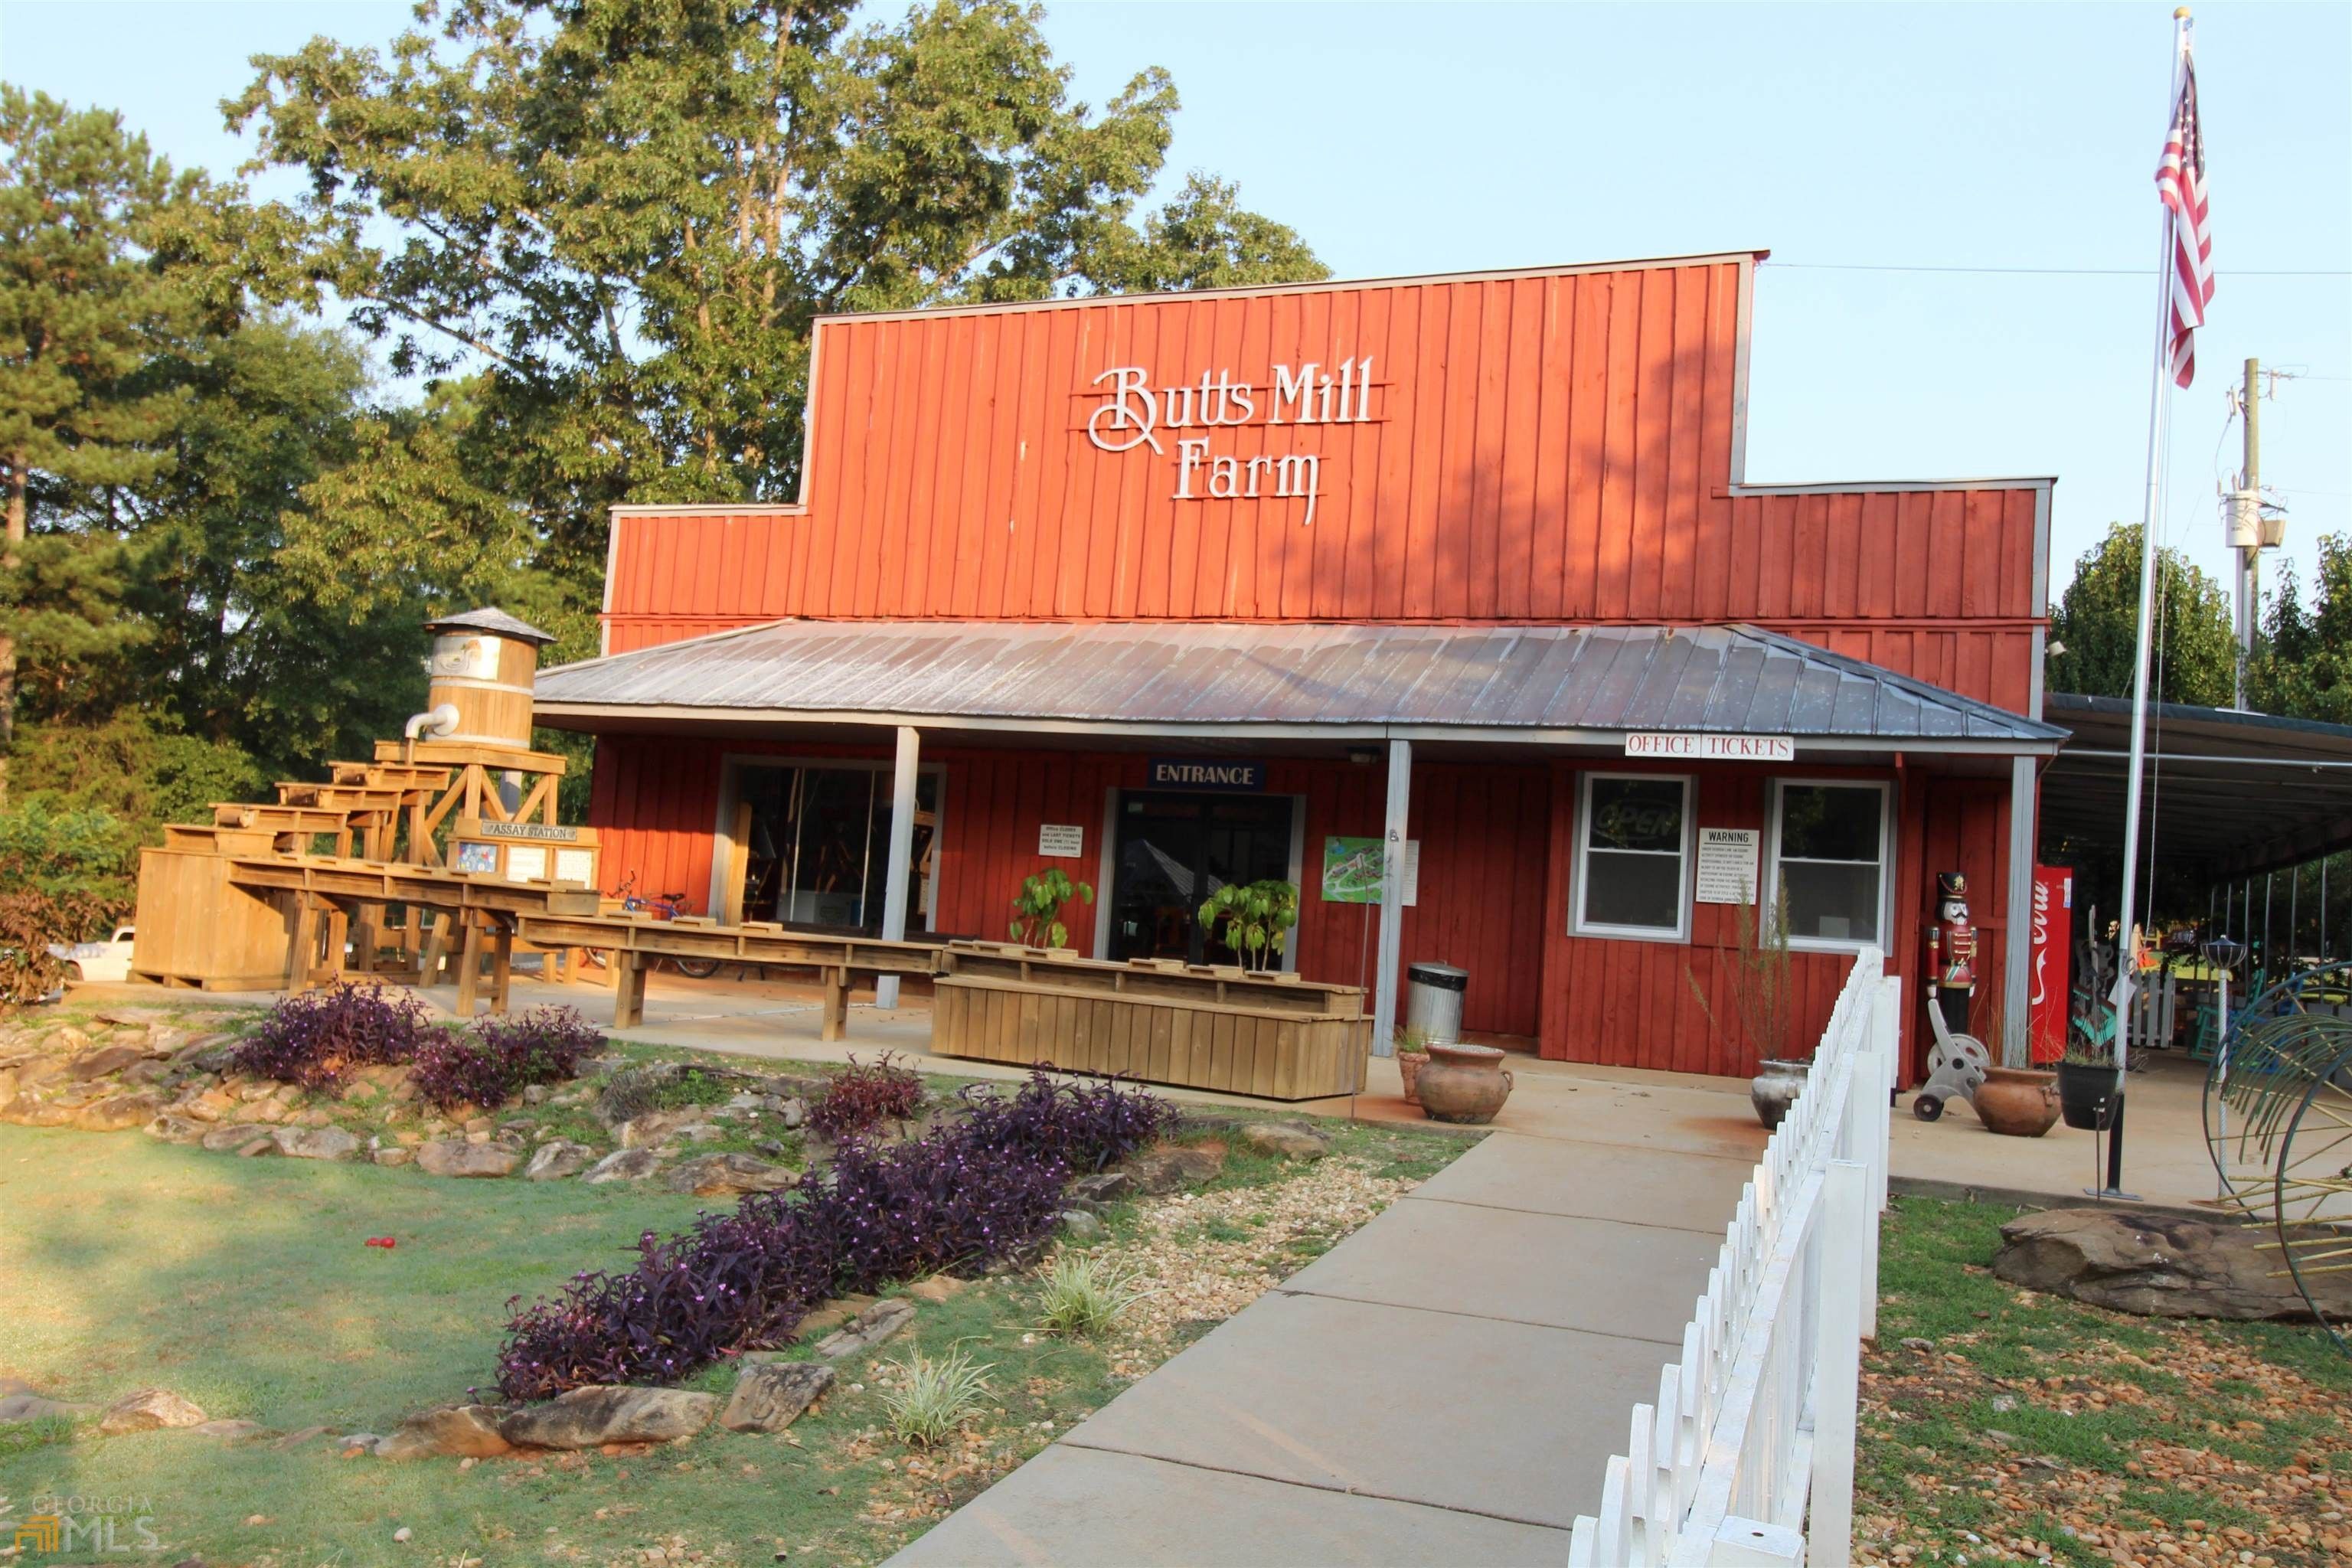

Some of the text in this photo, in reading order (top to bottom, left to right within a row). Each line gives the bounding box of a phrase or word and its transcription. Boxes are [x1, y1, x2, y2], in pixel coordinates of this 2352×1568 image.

[1088, 355, 1374, 456] Butts Mill
[1172, 436, 1319, 526] Farm
[1628, 734, 1789, 757] OFFICE TICKETS
[1156, 764, 1254, 785] ENTRANCE
[493, 825, 567, 839] ASSAY STATION
[1708, 831, 1749, 843] WARNING
